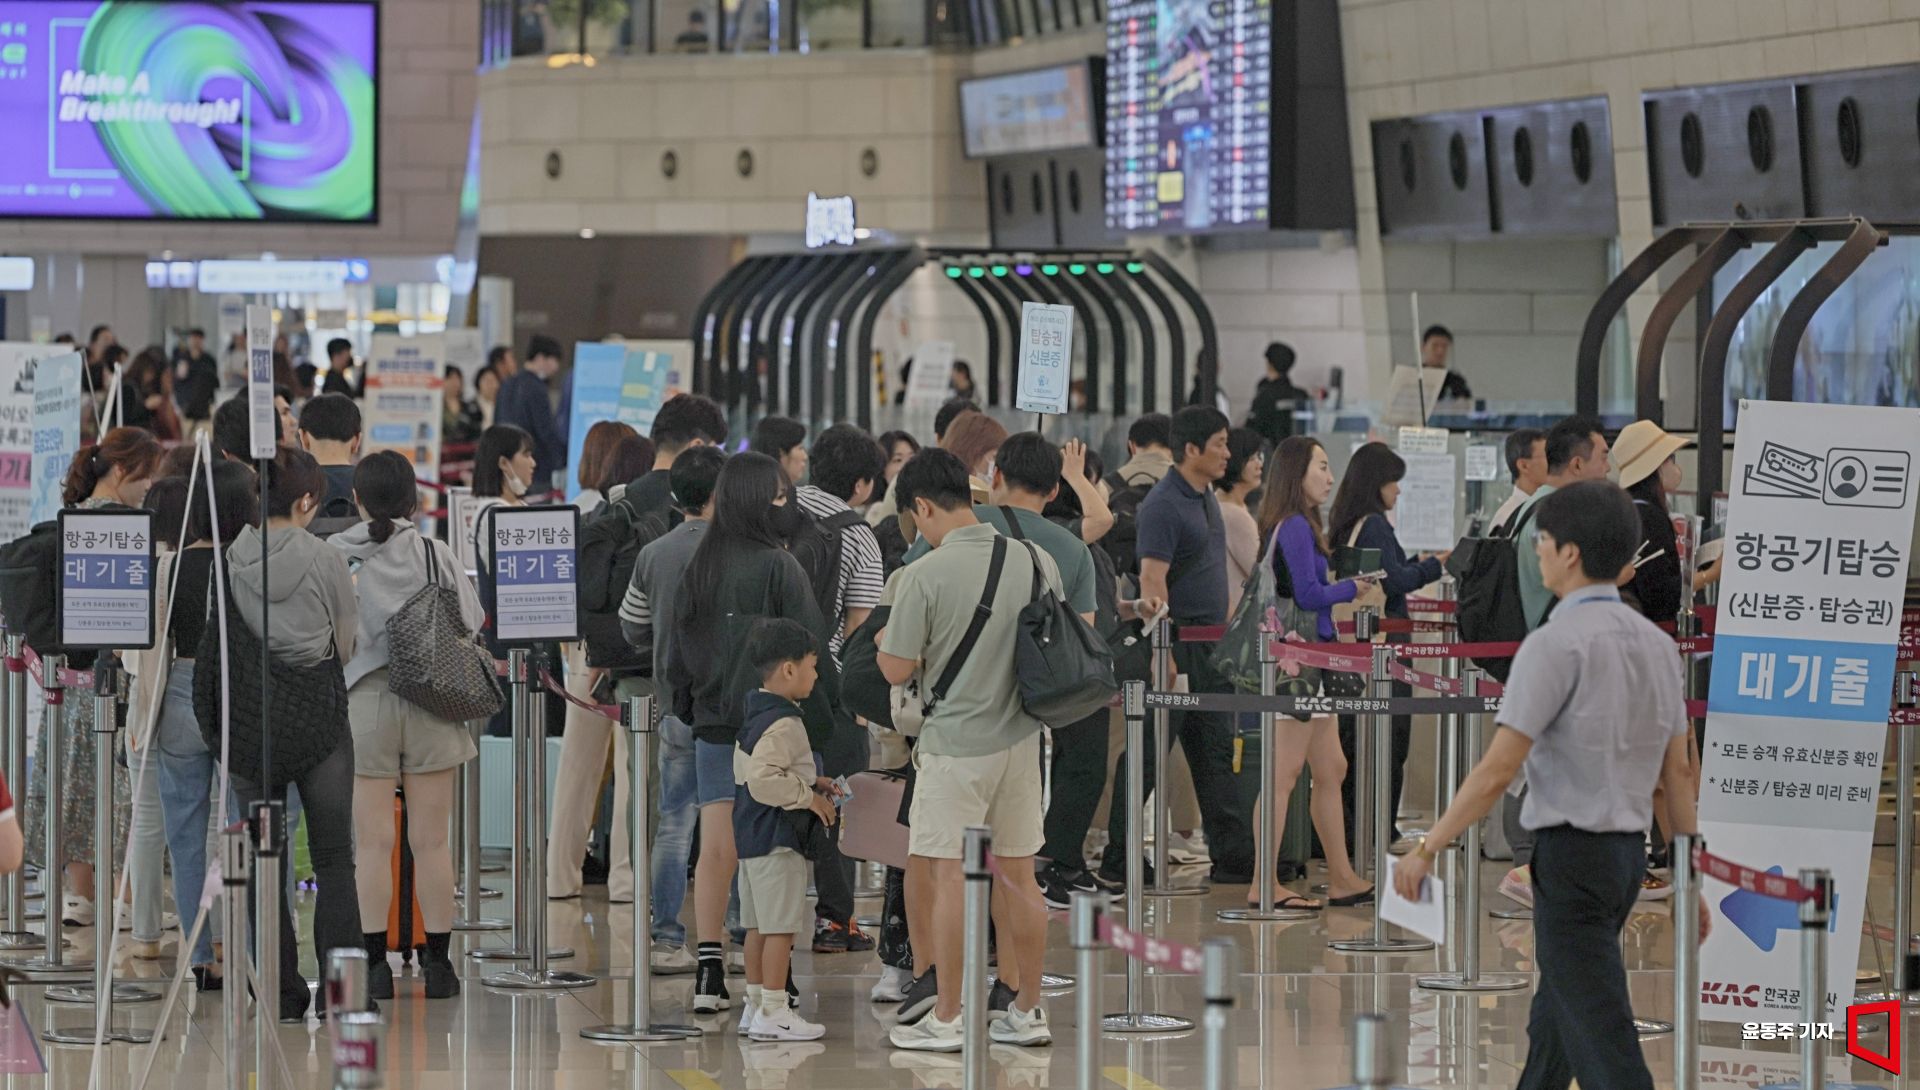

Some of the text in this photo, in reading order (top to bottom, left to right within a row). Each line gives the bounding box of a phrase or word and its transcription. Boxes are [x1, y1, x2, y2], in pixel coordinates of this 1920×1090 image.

[60, 70, 150, 95] Make A
[59, 97, 241, 128] Breakthrough!
[1031, 328, 1062, 347] 탑승권
[1029, 350, 1061, 368] 신분증
[65, 531, 147, 550] 항공기탑승
[497, 527, 572, 546] 항공기탑승
[1735, 532, 1901, 578] 항공기탑승
[1405, 646, 1449, 655] 한국공항공사
[1738, 651, 1870, 706] 대기줄
[1146, 693, 1200, 705] 한국공항공사
[1294, 697, 1390, 711] KAC 한국공항공사
[1721, 744, 1878, 768] 모든 승객 유효신분증 확인
[1720, 778, 1759, 795] 신분증
[1773, 781, 1811, 799] 탑승권
[1816, 783, 1842, 801] 미리
[1846, 786, 1872, 802] 준비
[1701, 981, 1760, 1008] KAC
